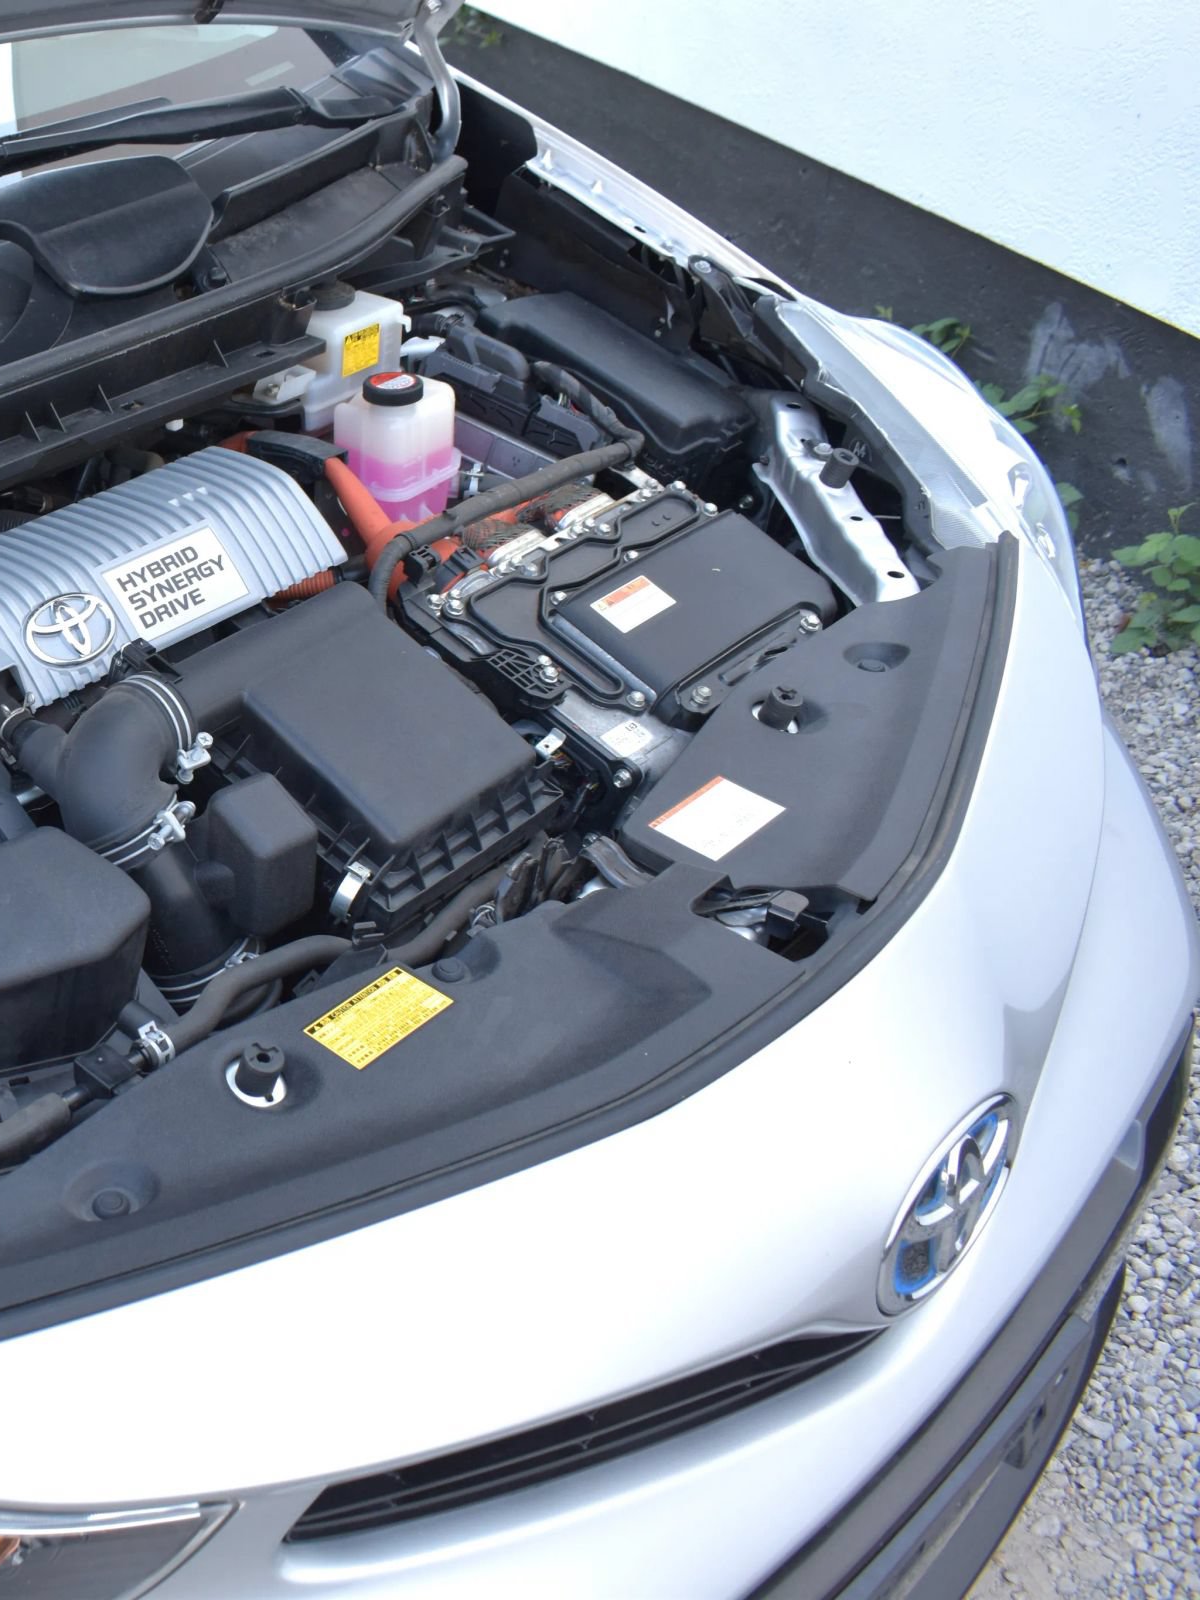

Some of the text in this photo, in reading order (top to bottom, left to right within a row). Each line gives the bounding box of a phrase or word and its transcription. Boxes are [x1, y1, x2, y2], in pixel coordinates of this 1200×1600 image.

[116, 546, 199, 592] HYBRID
[128, 554, 225, 611] SYNERGY
[138, 588, 206, 629] DRIVE
